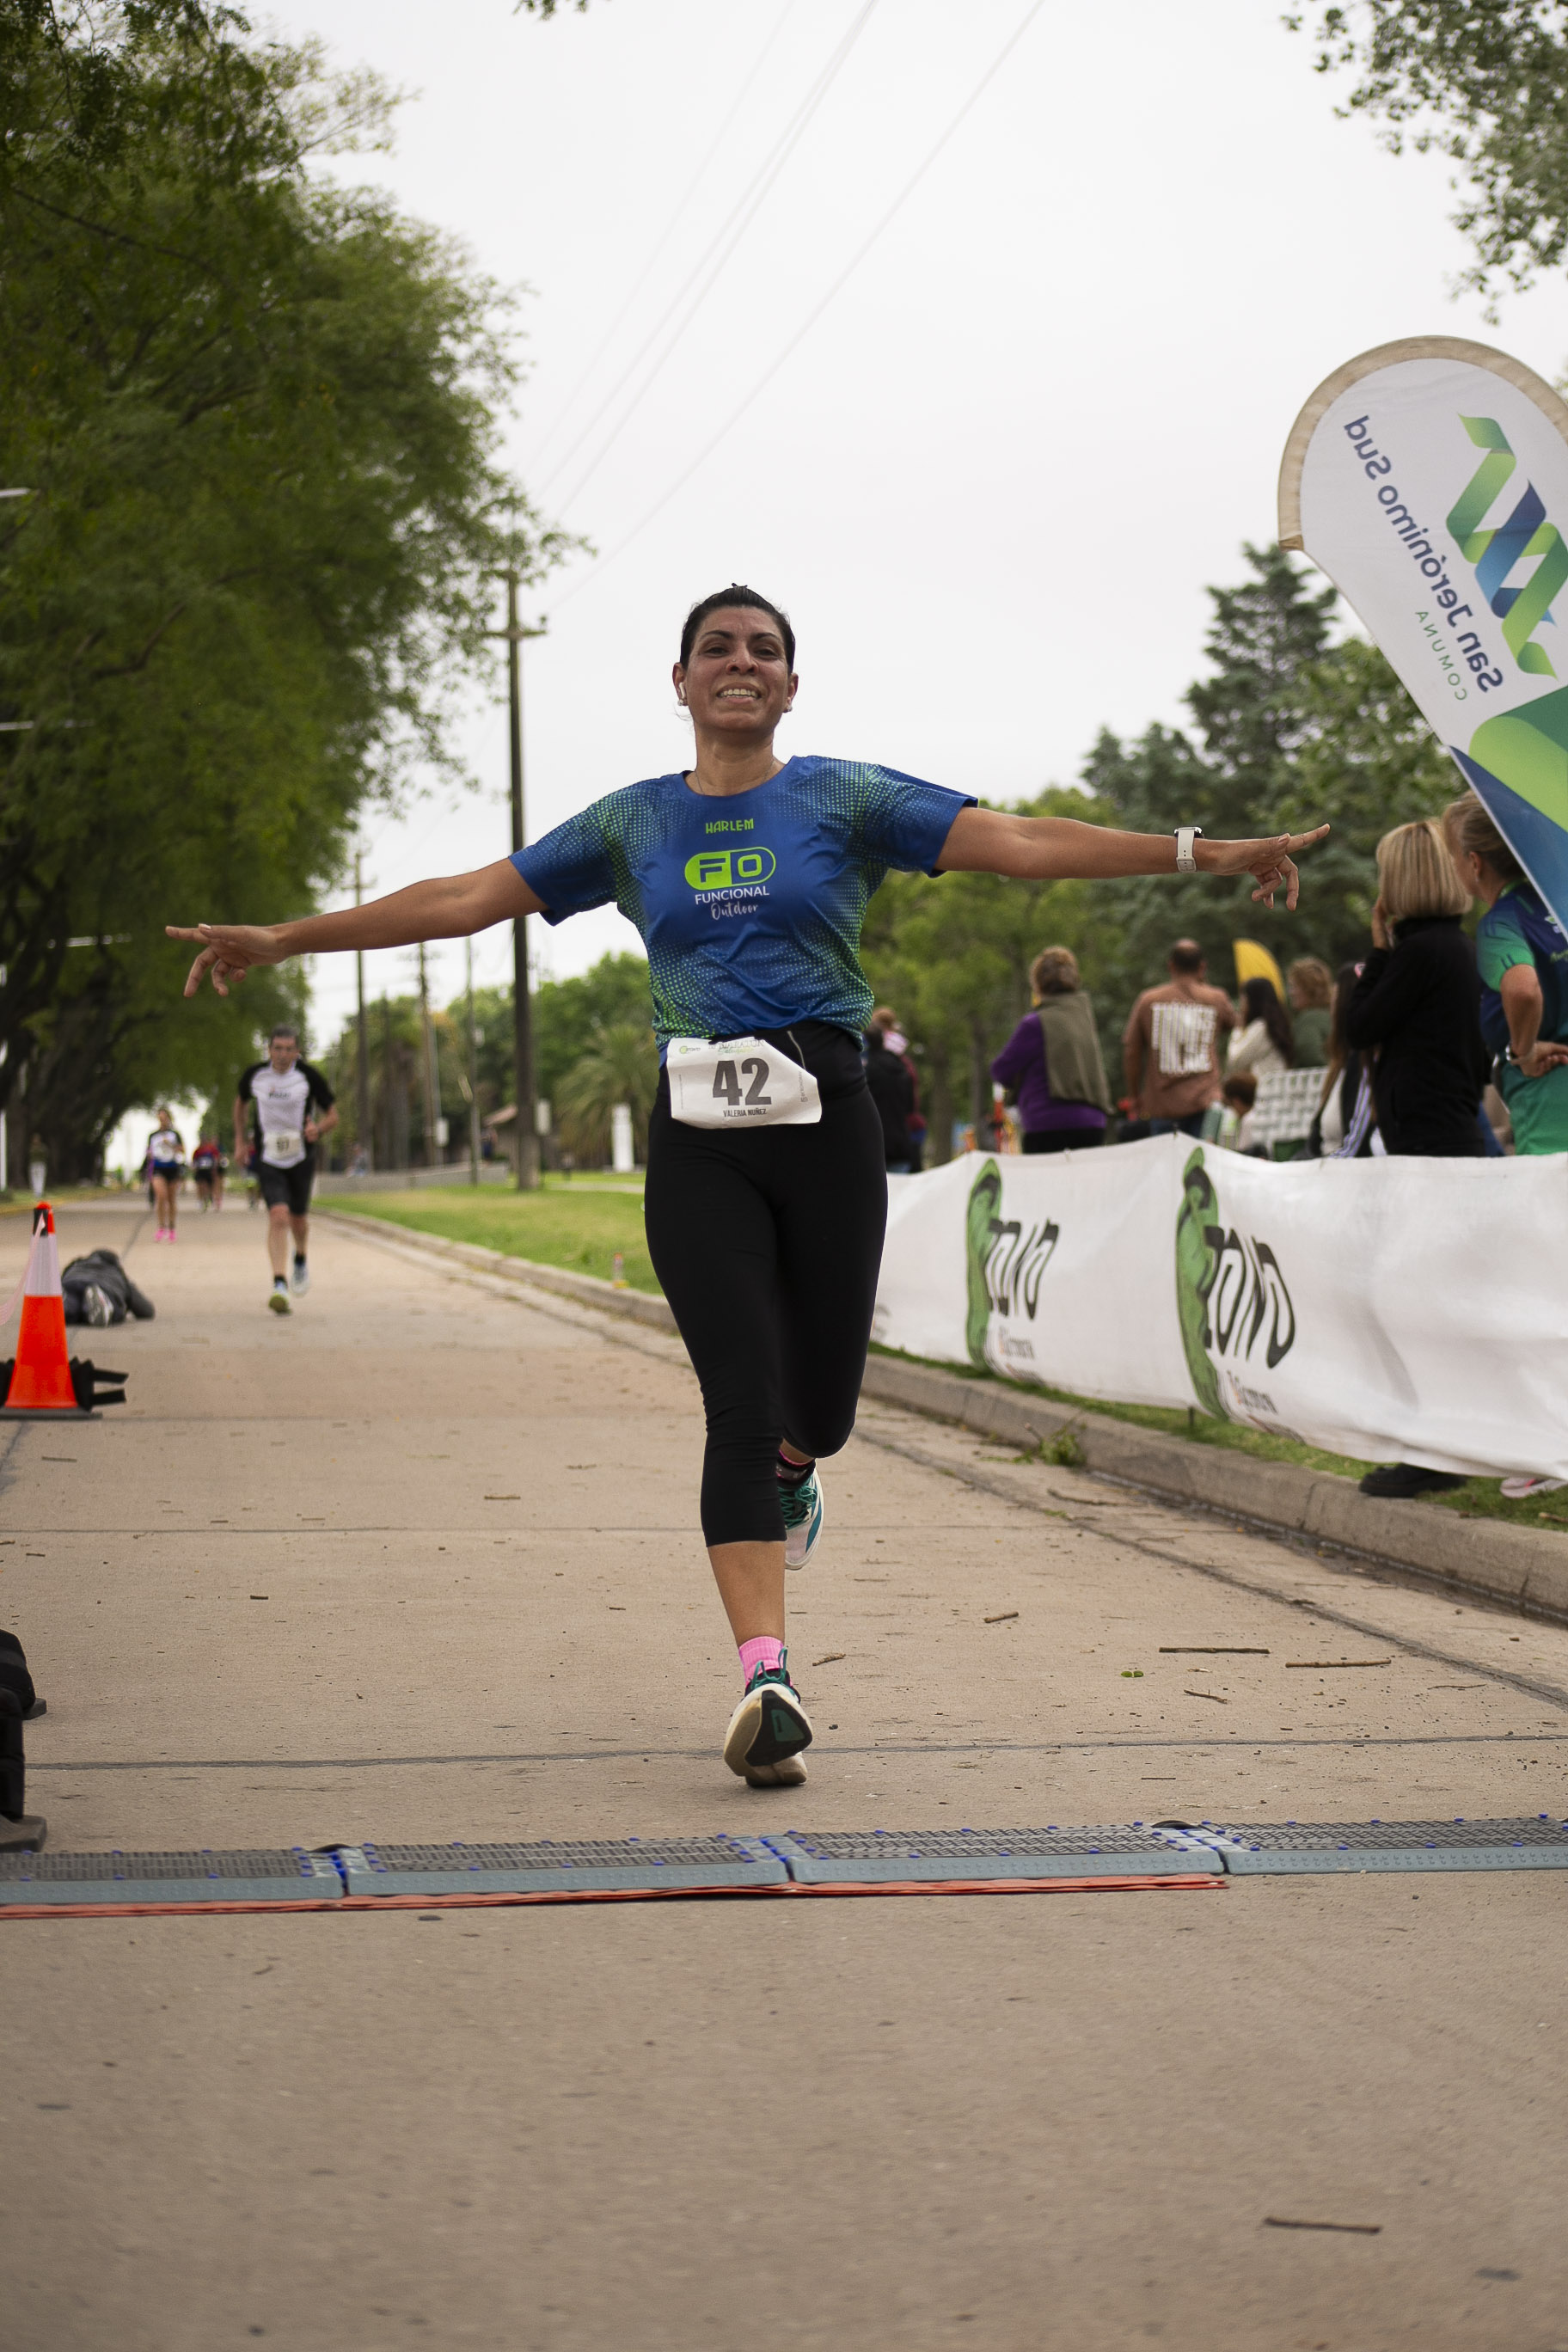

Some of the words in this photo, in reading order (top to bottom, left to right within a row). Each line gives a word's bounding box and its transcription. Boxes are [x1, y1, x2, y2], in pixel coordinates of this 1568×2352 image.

[705, 818, 755, 835] HARLEM
[695, 885, 770, 905] FUNCIONAL
[710, 901, 758, 921] Outdoor
[712, 1057, 773, 1106] 42
[723, 1109, 747, 1118] VALERIA
[747, 1107, 768, 1117] NUÑEZ
